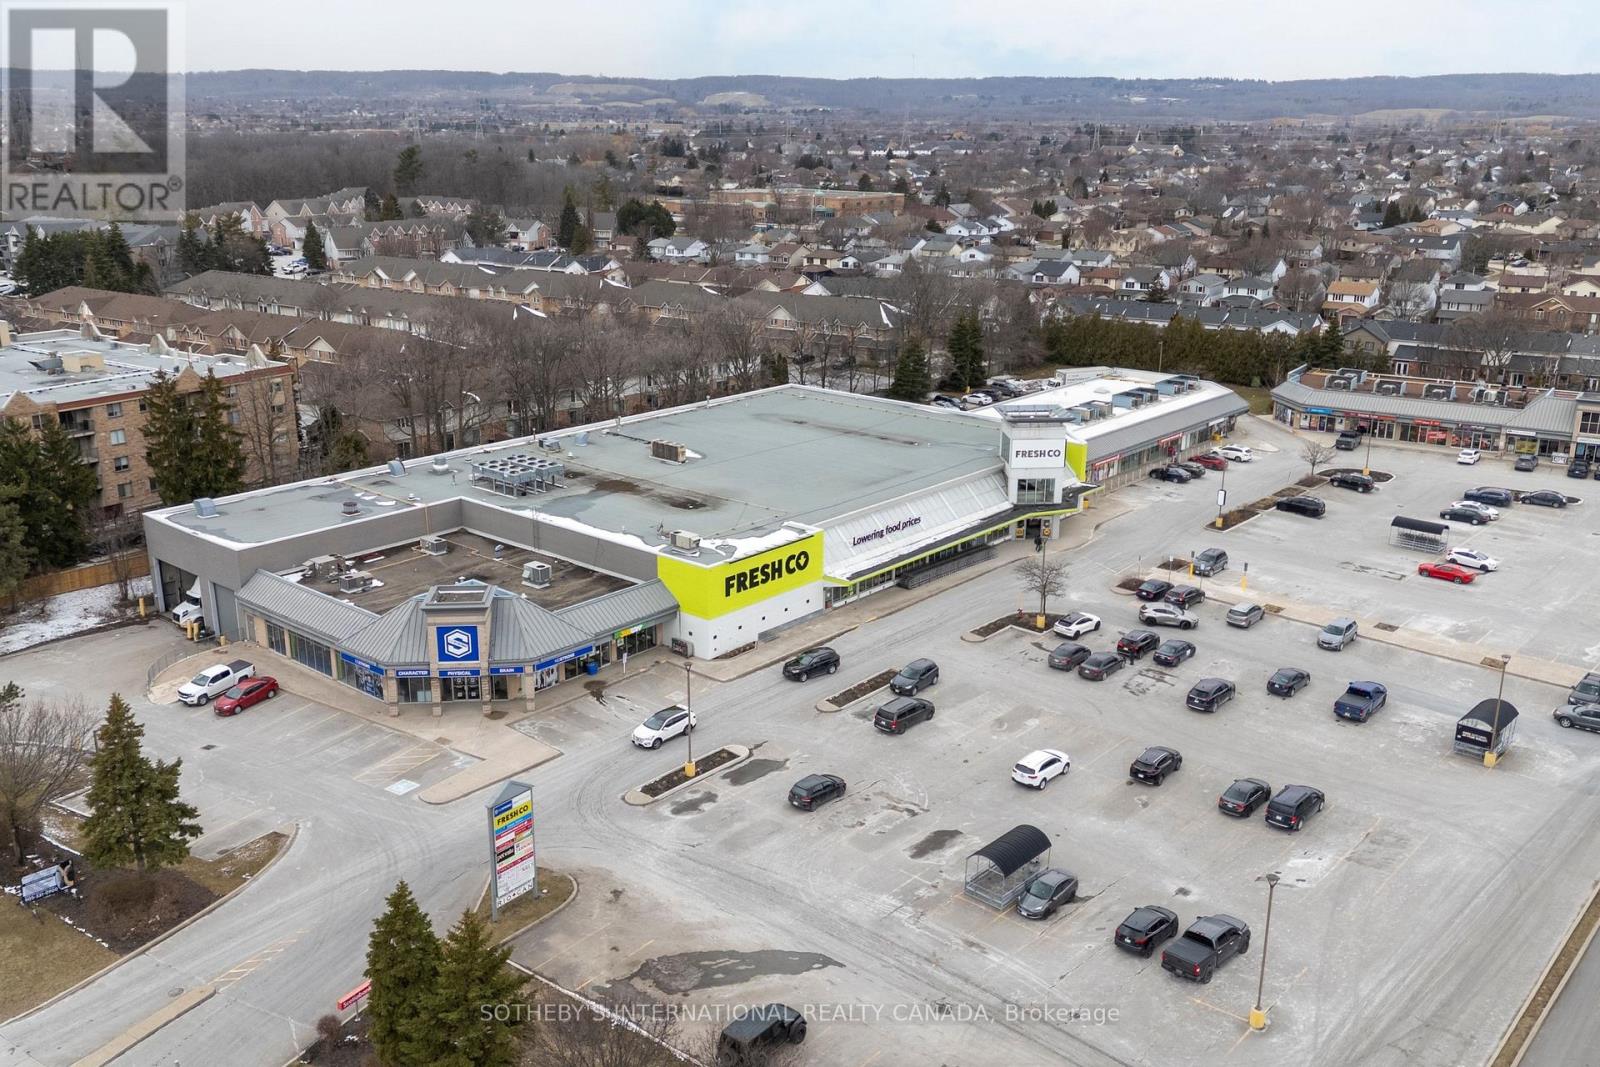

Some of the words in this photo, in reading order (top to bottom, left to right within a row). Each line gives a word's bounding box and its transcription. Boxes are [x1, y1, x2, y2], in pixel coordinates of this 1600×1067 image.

[852, 529, 885, 547] Lowering
[885, 520, 901, 535] food
[901, 515, 921, 533] prices
[725, 558, 783, 597] FRESH
[784, 550, 810, 575] CO
